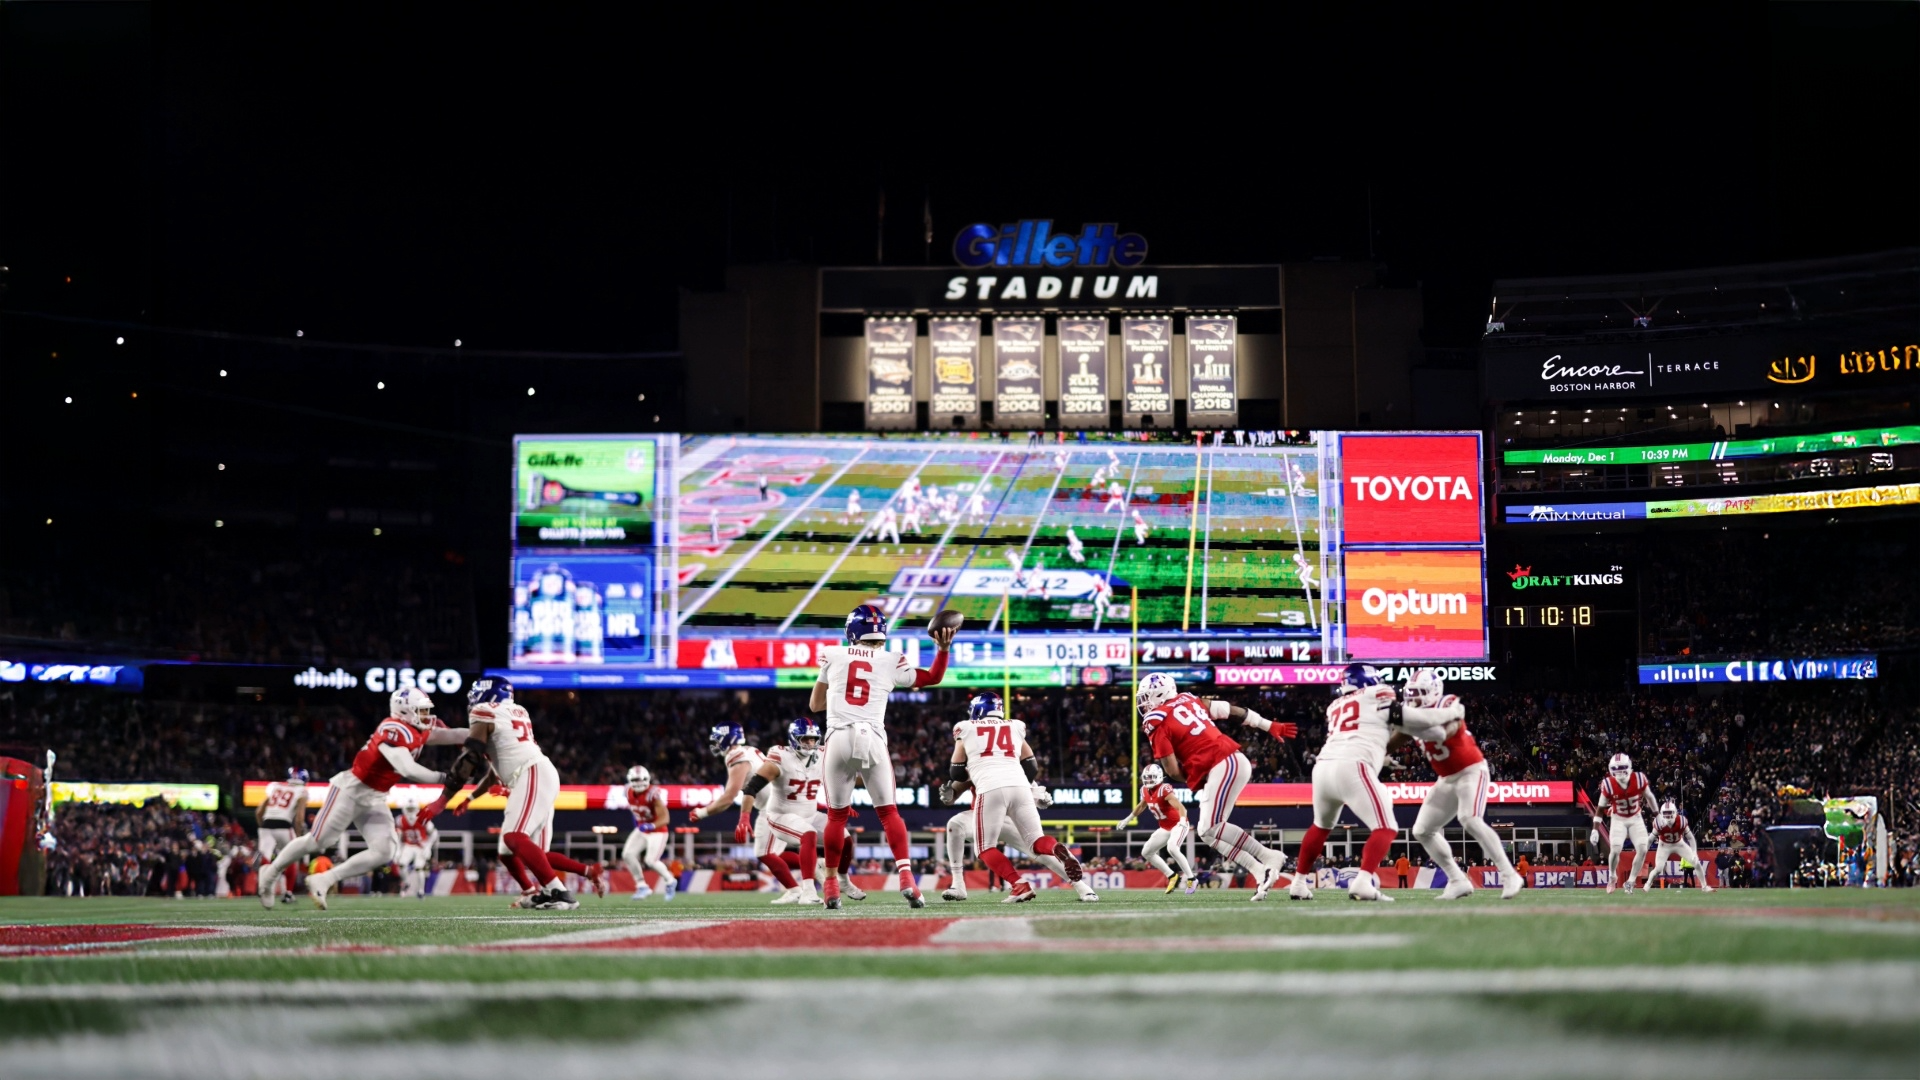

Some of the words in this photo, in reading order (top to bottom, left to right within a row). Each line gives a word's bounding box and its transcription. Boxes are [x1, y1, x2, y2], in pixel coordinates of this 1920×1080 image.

[953, 219, 1149, 269] Gillette
[944, 275, 1158, 300] STADIUM
[1541, 354, 1644, 380] Encore
[1657, 361, 1720, 373] TERRACE
[1134, 385, 1162, 393] WORLD
[1199, 384, 1226, 392] WORLD
[1550, 383, 1591, 392] BOSTON
[1594, 381, 1636, 391] HARBOR
[1191, 391, 1234, 400] CHAMPIONS
[871, 401, 910, 413] 2001
[935, 400, 976, 413] 2003
[999, 400, 1040, 413] 2004
[1065, 400, 1103, 412] 2014
[1130, 400, 1168, 412] 2016
[1194, 399, 1232, 410] 2018
[1542, 453, 1586, 465] Monday,
[1587, 452, 1607, 462] Dec
[1609, 451, 1615, 462] 1
[1640, 450, 1669, 461] 10:39
[1672, 448, 1688, 459] PM
[1350, 475, 1473, 501] TOYOTA
[1572, 509, 1626, 521] Mutual
[1511, 573, 1624, 590] DRAFTKINGS
[1361, 587, 1468, 622] Optum
[1506, 607, 1524, 626] 17
[1541, 606, 1591, 626] 10:18
[782, 642, 811, 665] 30
[848, 647, 876, 658] DART
[953, 642, 975, 663] 15
[1046, 644, 1098, 659] 10:18
[1108, 644, 1126, 659] 17
[1174, 646, 1184, 658] &
[1188, 641, 1210, 662] 12
[1244, 645, 1268, 658] BALL
[1269, 645, 1283, 658] ON
[1289, 641, 1311, 661] 12
[364, 667, 463, 693] CISCO
[844, 659, 873, 707] 6
[1217, 669, 1283, 682] TOYOTA
[1172, 701, 1216, 736] 94
[1330, 699, 1360, 736] 72
[976, 725, 1016, 758] 74
[786, 778, 821, 801] 76
[1487, 782, 1550, 801] Optum
